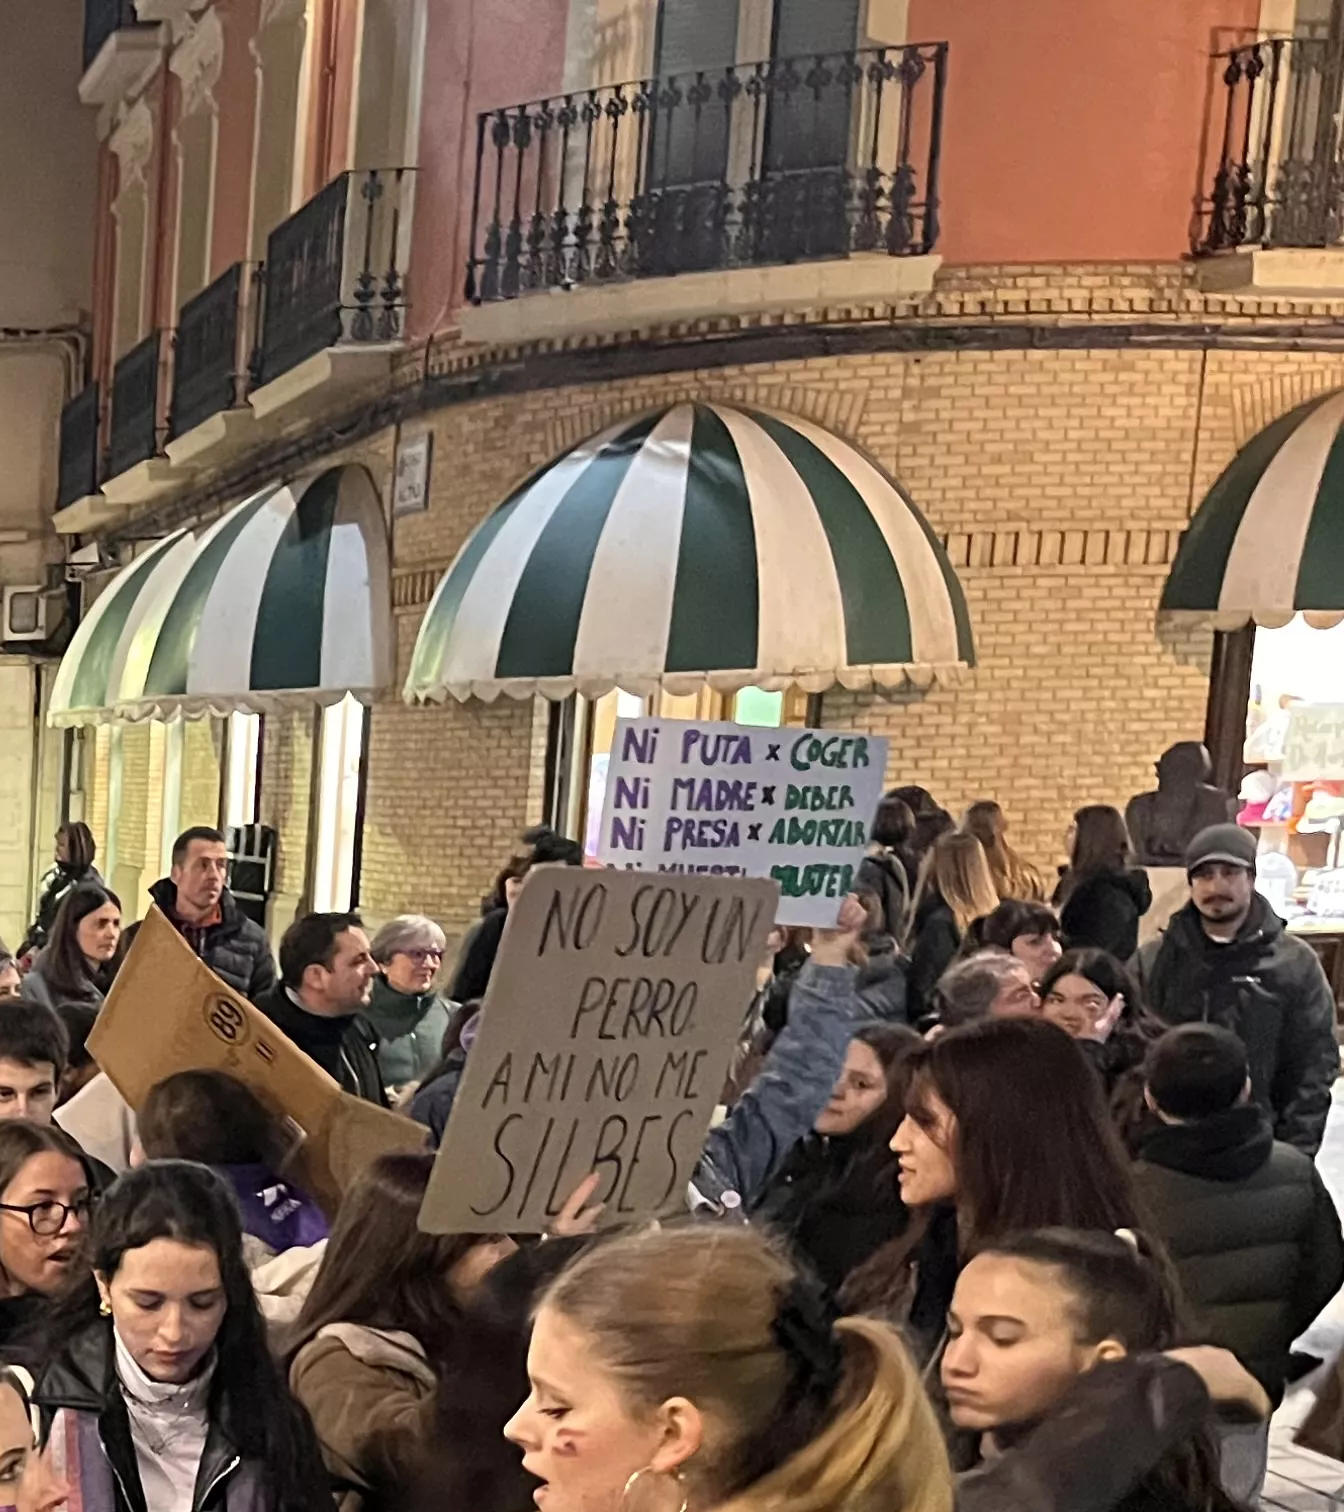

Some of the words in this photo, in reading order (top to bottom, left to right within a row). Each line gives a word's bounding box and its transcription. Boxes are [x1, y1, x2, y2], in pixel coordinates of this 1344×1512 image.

[622, 727, 660, 764] Ni
[681, 729, 752, 766] PUTA
[790, 733, 869, 771] COGER
[614, 776, 650, 809] Ni
[671, 777, 757, 811] MADRE
[784, 784, 854, 811] DEBER
[610, 817, 645, 850] Ni
[664, 817, 740, 851] PRESA
[768, 817, 865, 847] ABORTAR
[538, 883, 608, 957] NO
[615, 885, 700, 958] SOY
[701, 896, 765, 964] UN
[570, 976, 699, 1040] PERRO
[481, 1052, 513, 1109] A
[523, 1052, 576, 1103] MI
[584, 1052, 640, 1101] NO
[654, 1050, 708, 1099] ME
[470, 1109, 694, 1220] SILBES
